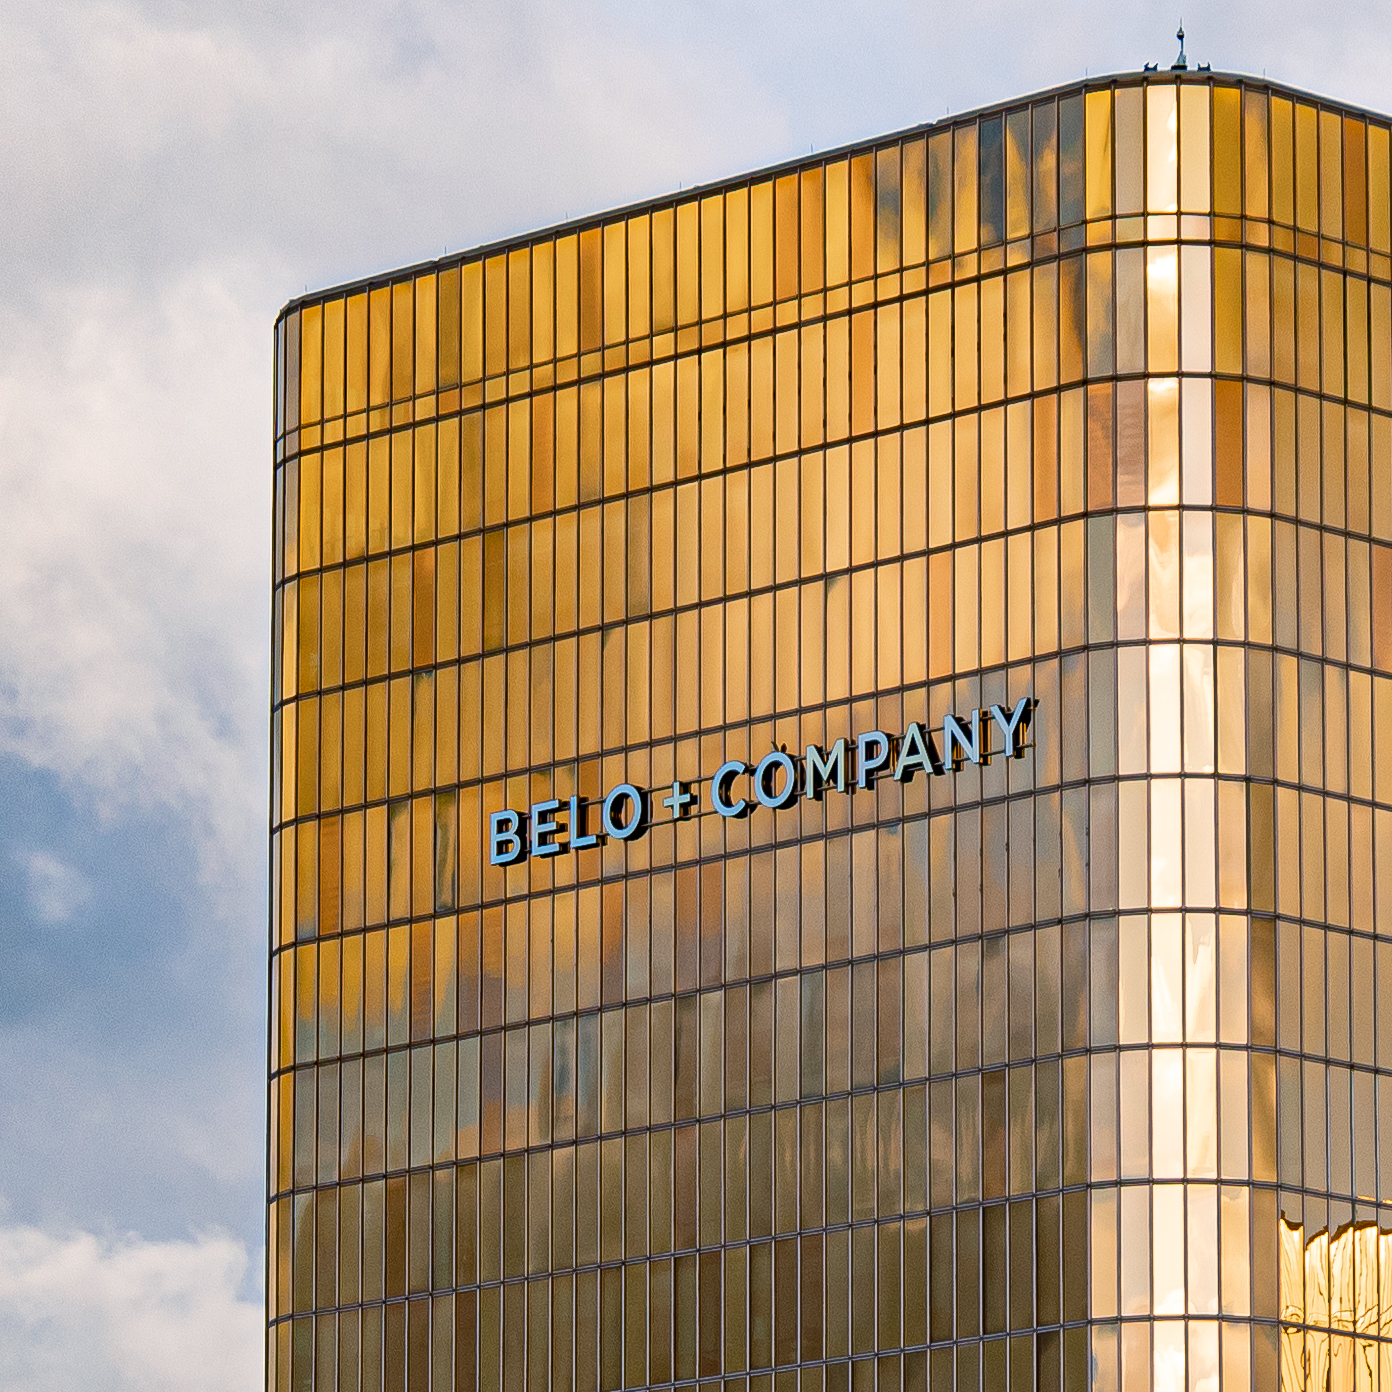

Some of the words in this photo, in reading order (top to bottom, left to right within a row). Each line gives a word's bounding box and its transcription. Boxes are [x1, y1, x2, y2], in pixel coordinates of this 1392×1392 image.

[489, 782, 645, 866] BELO
[663, 780, 690, 818] +
[710, 697, 1035, 818] COMPANY
